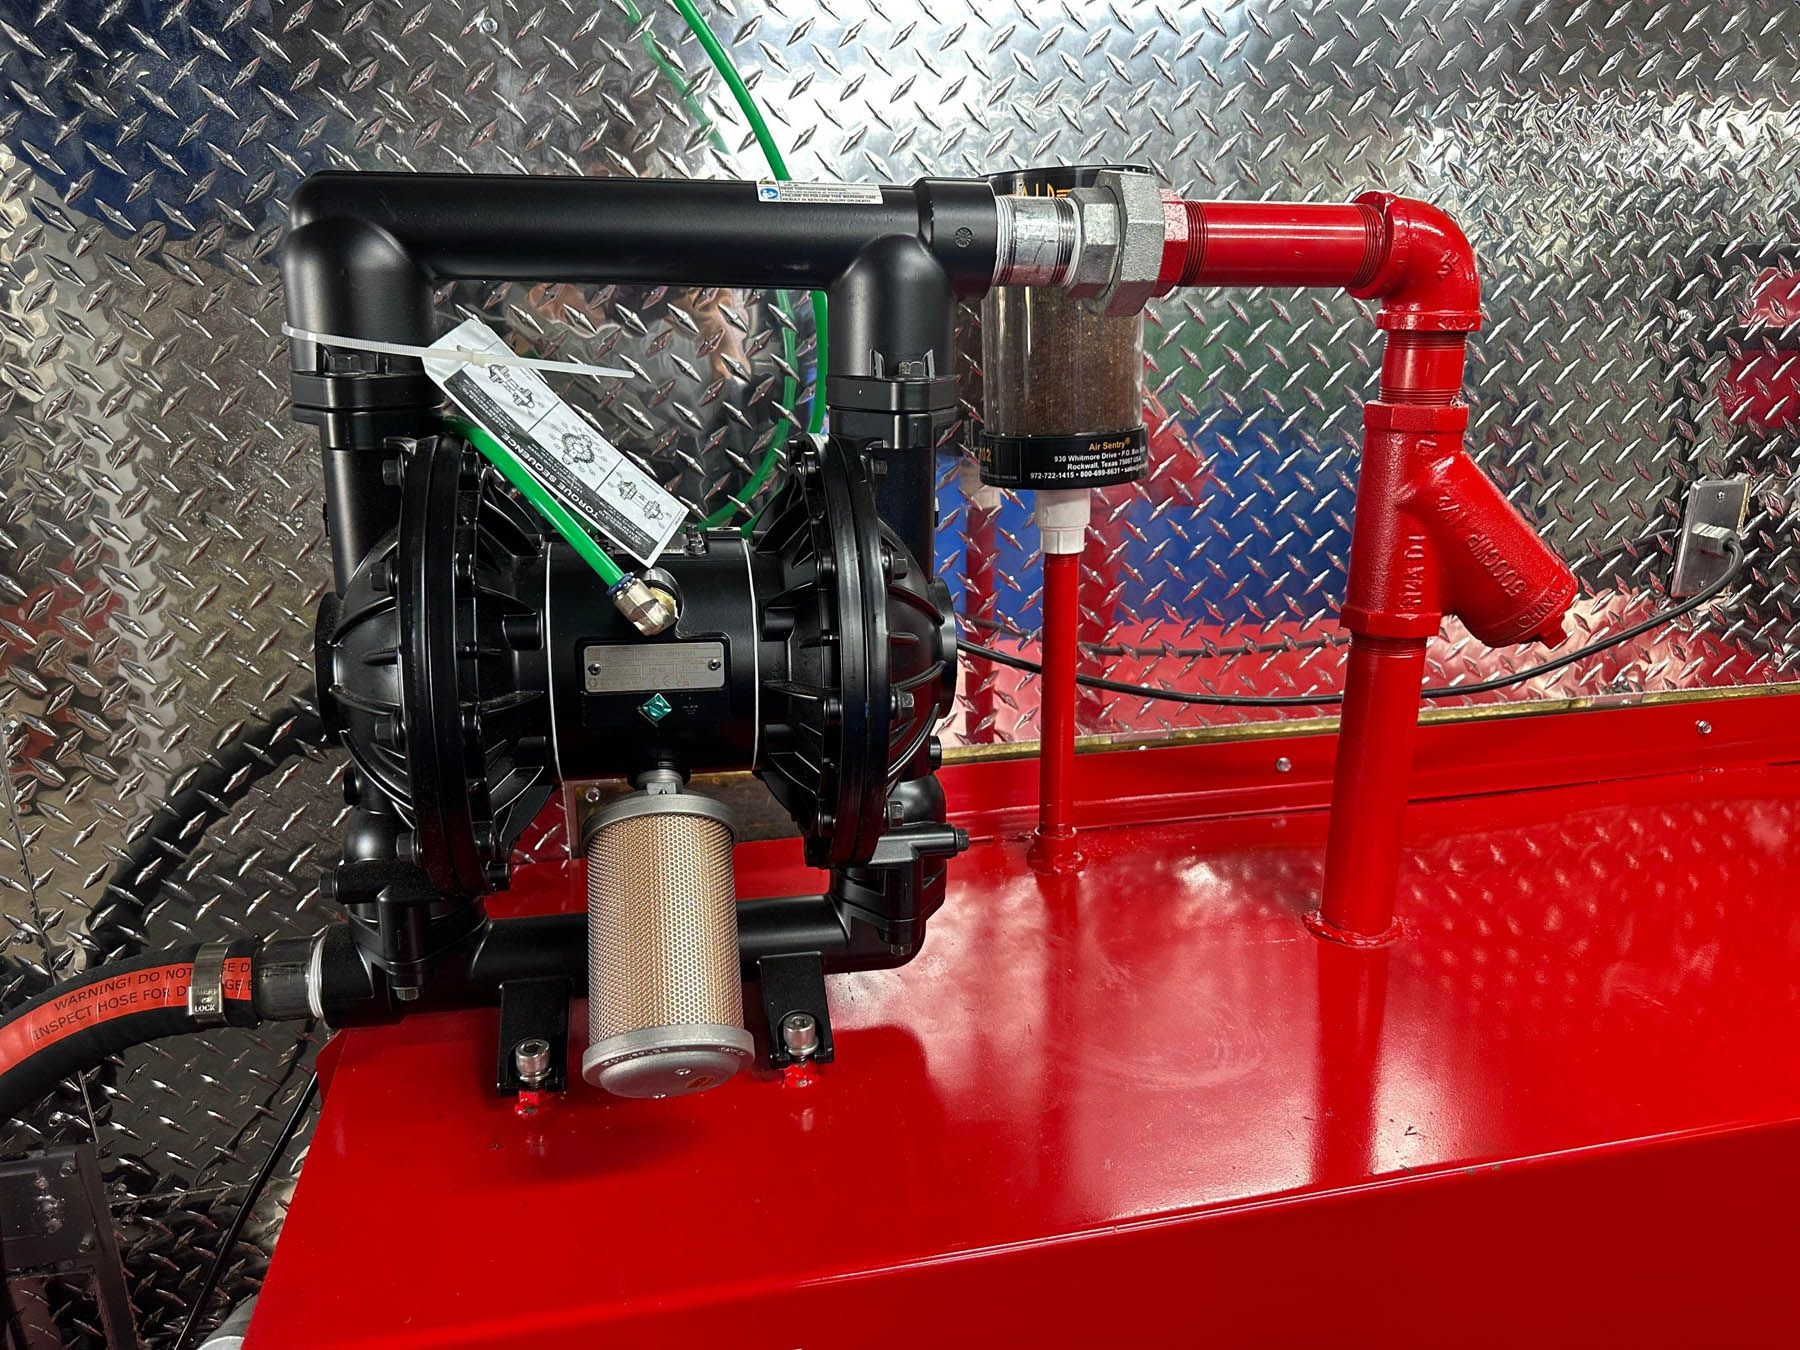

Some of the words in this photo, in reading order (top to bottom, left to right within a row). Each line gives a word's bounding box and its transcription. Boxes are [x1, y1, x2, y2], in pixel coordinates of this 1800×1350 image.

[1088, 442, 1101, 451] Air
[501, 432, 557, 483] SEQUENCE
[1068, 454, 1100, 462] Whitmore
[1067, 462, 1099, 470] Rockwall,
[1030, 471, 1074, 479] 972-722-1415
[557, 481, 600, 519] TORQUE
[54, 977, 131, 1010] WARNING!
[138, 972, 160, 984] DO
[166, 968, 192, 979] NOT
[194, 1004, 216, 1012] LOCK
[33, 1005, 92, 1040] INSPECT
[98, 992, 137, 1012] HOSE
[143, 987, 171, 1000] FOR
